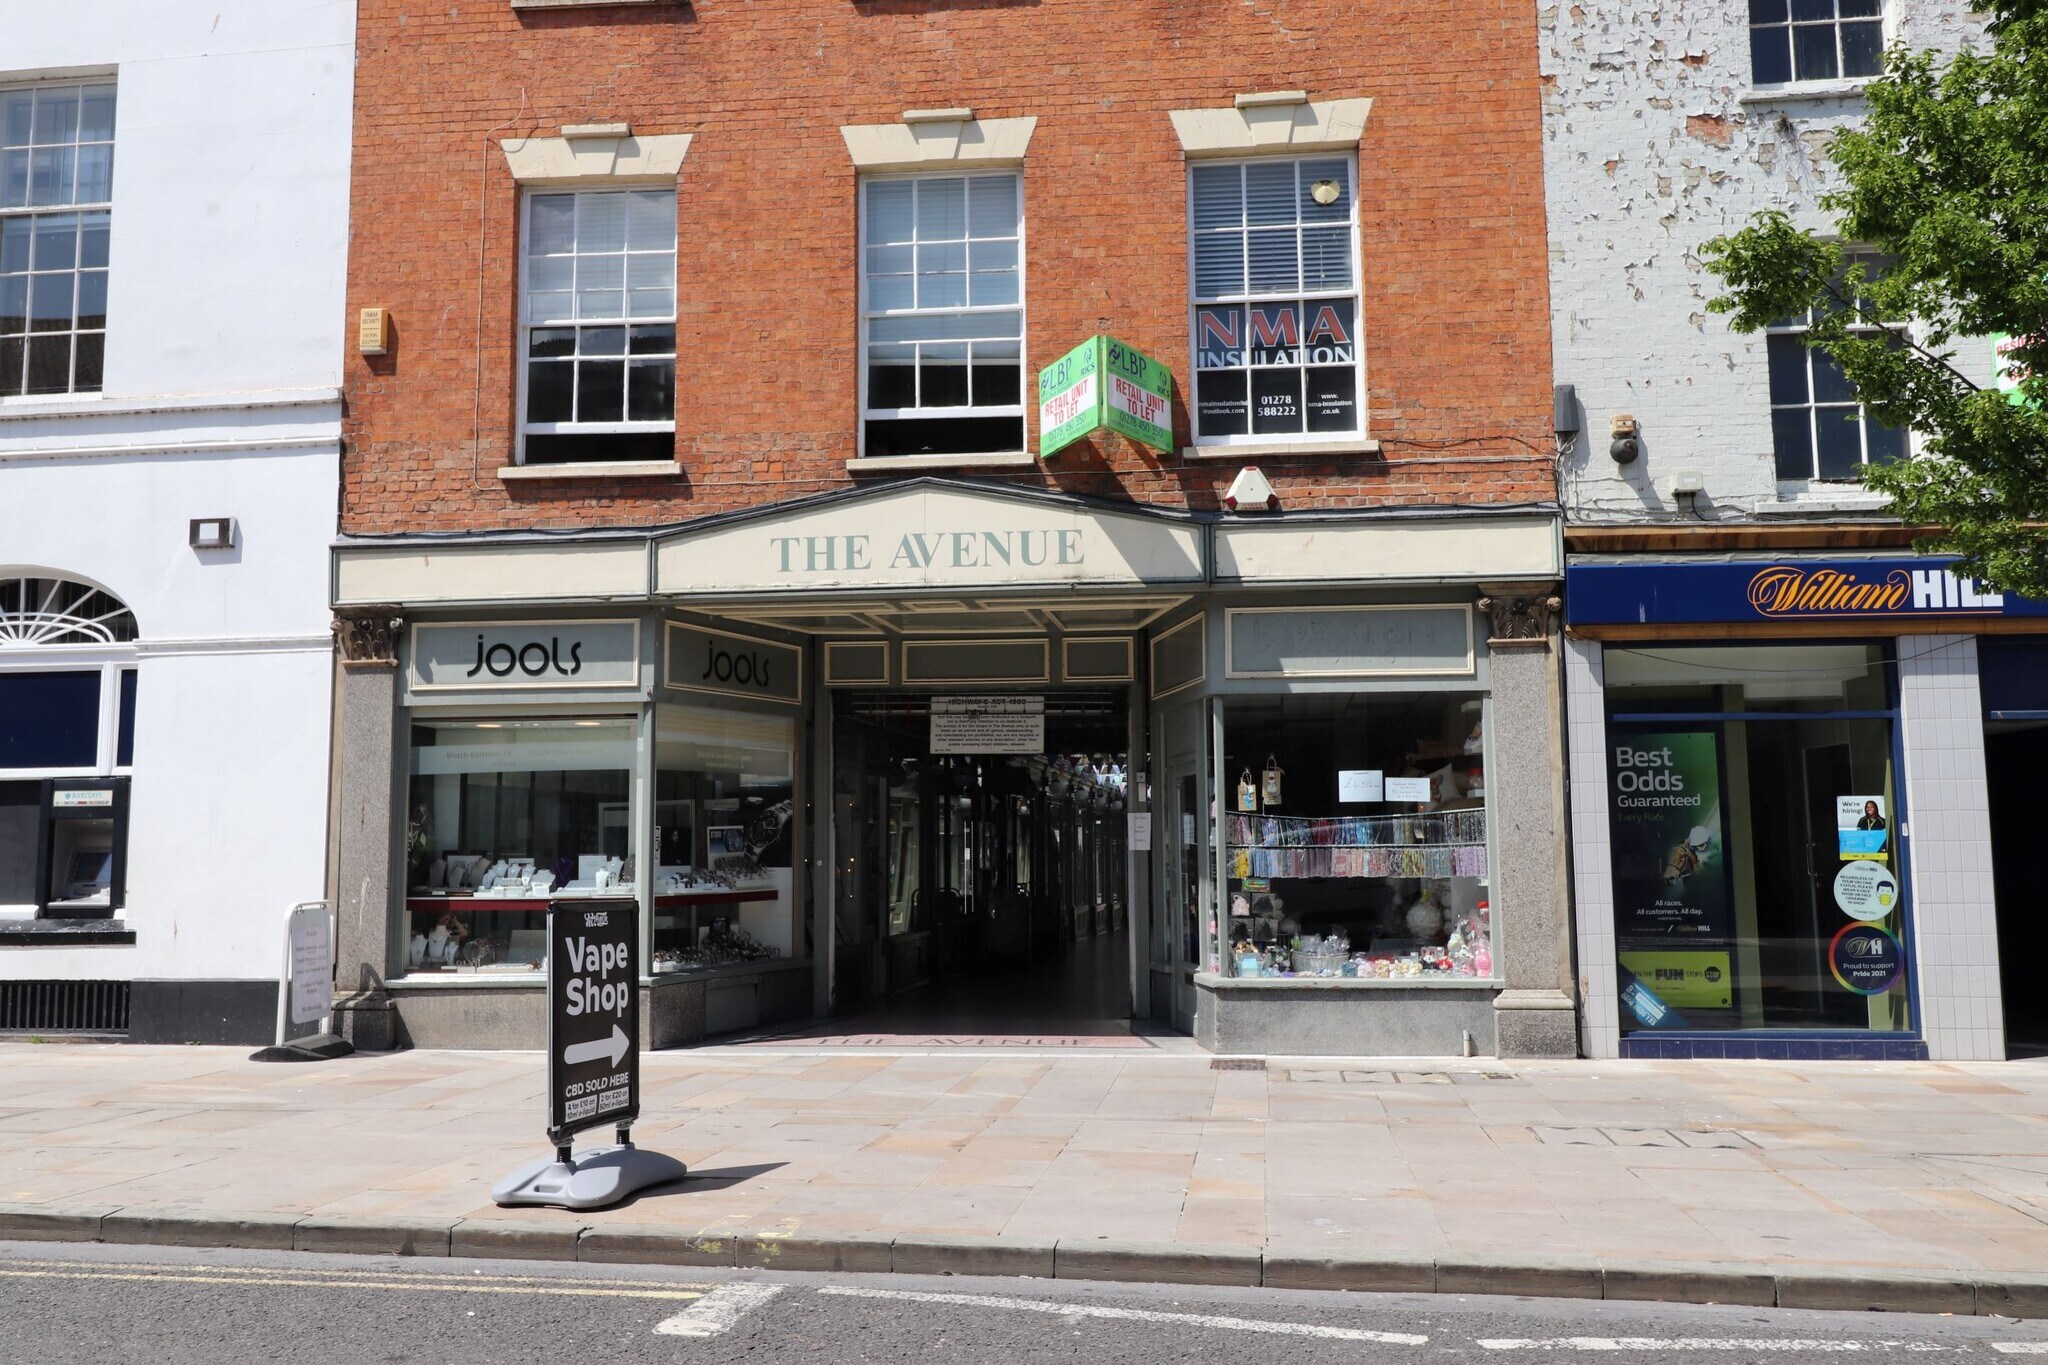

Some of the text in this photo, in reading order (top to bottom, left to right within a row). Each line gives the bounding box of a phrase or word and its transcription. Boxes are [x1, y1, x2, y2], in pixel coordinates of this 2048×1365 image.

[1199, 305, 1351, 348] NMA
[1050, 357, 1072, 391] LBP
[1080, 361, 1095, 376] RICS
[1120, 348, 1146, 378] LBP
[1045, 391, 1069, 418] RETAIL
[1072, 378, 1088, 401] UNIT
[1116, 378, 1164, 413] RETAIL UNIT
[1261, 395, 1292, 405] 01278
[1054, 400, 1078, 426] TO LET
[1120, 412, 1137, 428] 01278
[1127, 398, 1156, 423] TO LET
[1258, 406, 1296, 416] 588222
[770, 529, 1085, 572] THE AVENUE
[1748, 566, 1911, 613] William
[467, 634, 581, 678] jools
[702, 640, 769, 688] jools
[1616, 747, 1674, 768] Best
[1618, 770, 1684, 792] Odds
[1618, 794, 1701, 807] Guaranteed
[565, 936, 628, 980] Vape
[1655, 969, 1684, 980] FUN
[566, 978, 628, 1018] Shop
[566, 1072, 628, 1098] CBD SOLD HERE
[612, 1091, 621, 1099] £20
[567, 1106, 595, 1120] 10ml e-liquid
[580, 1099, 588, 1108] £10
[600, 1099, 628, 1111] 50ml e-liquid
